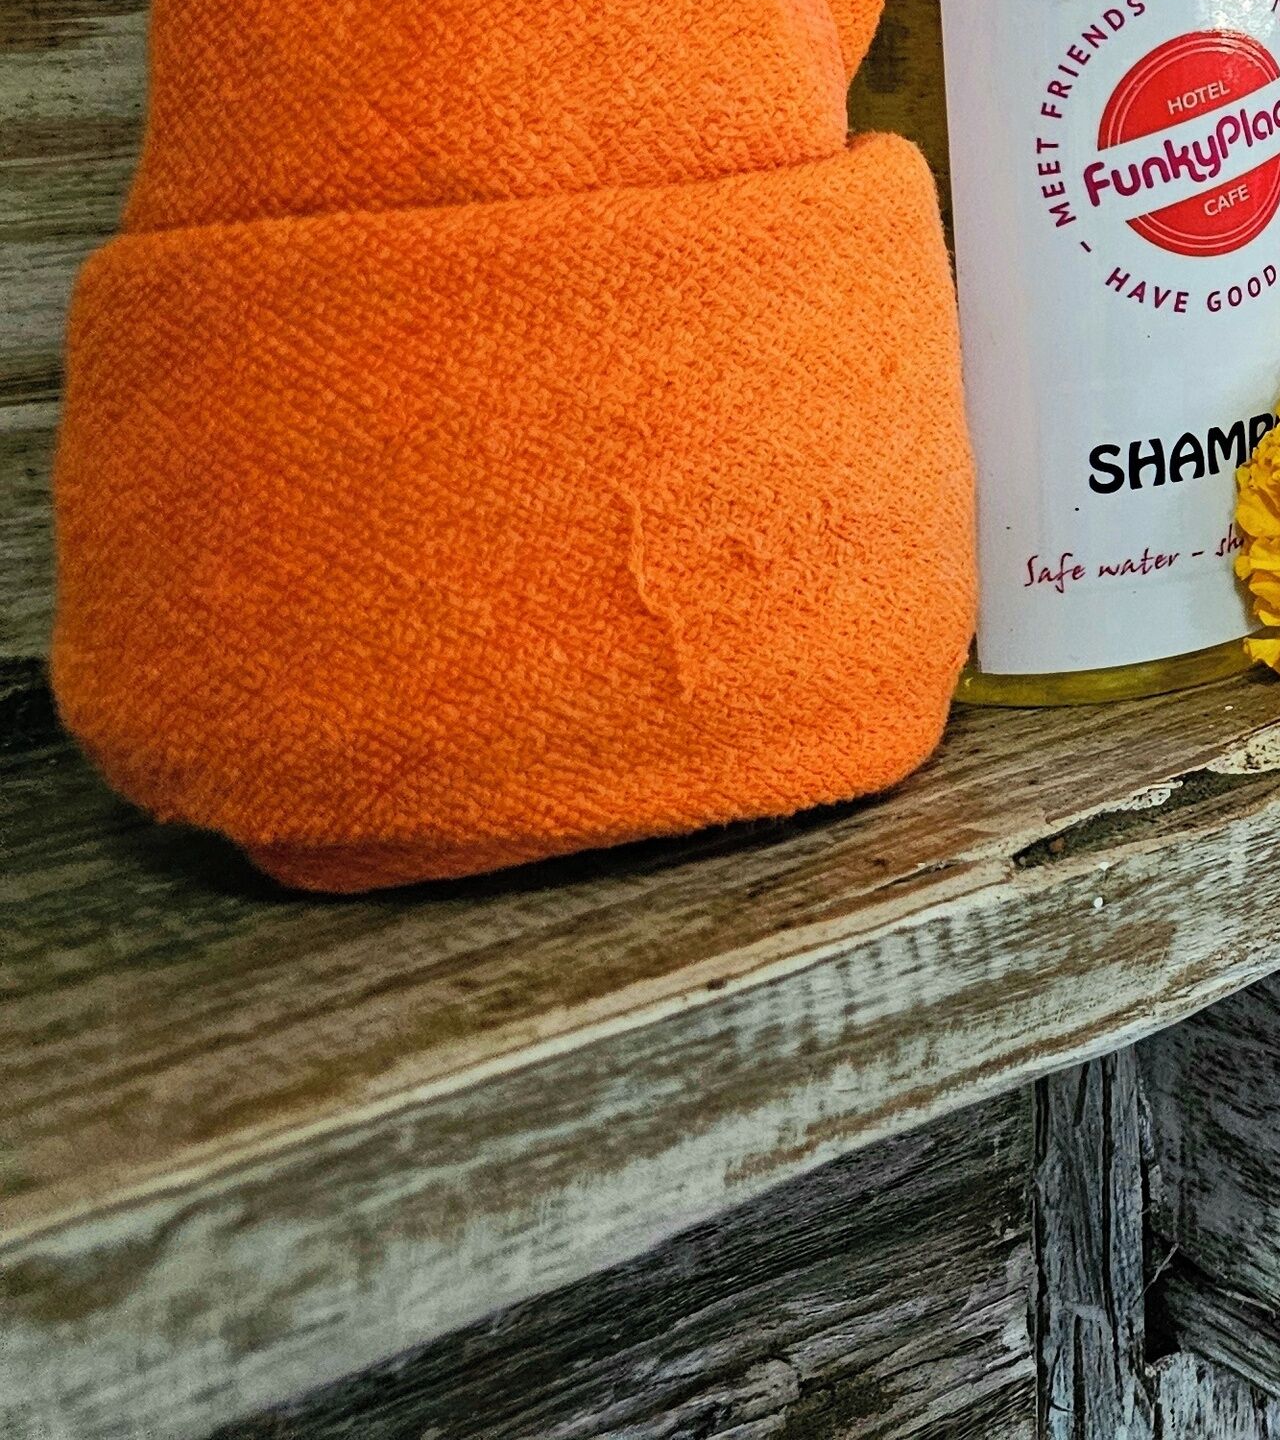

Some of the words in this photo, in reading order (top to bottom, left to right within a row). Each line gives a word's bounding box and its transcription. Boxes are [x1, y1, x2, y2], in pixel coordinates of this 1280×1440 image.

[1167, 79, 1231, 116] HOTEL
[1036, 137, 1078, 228] MEET
[1203, 184, 1251, 217] CAFE
[1105, 266, 1190, 314] HAVE
[1206, 264, 1278, 313] GOOD
[1088, 412, 1280, 495] SHAMP
[1023, 552, 1086, 594] Safe
[1098, 547, 1180, 578] water
